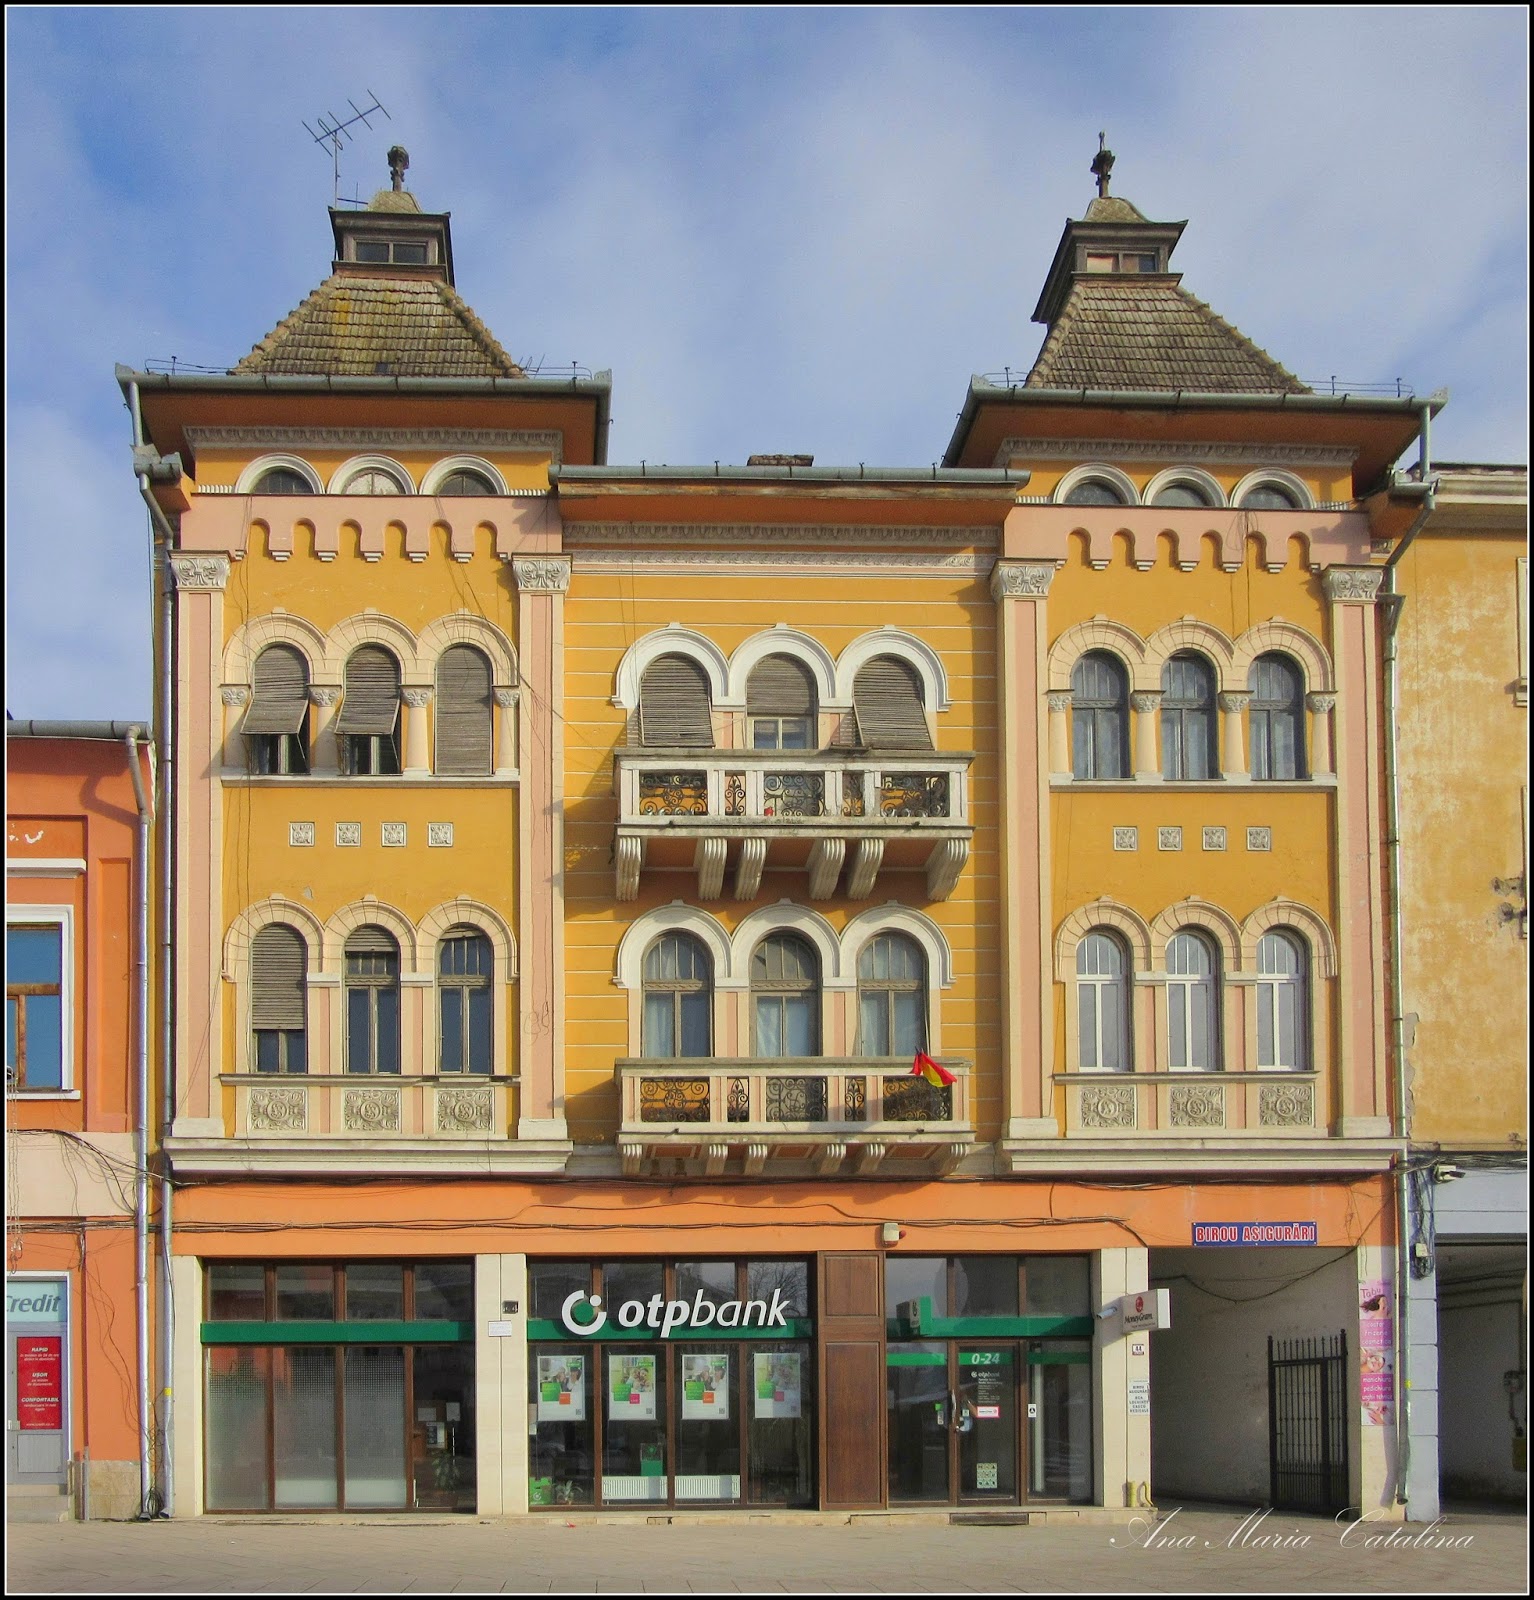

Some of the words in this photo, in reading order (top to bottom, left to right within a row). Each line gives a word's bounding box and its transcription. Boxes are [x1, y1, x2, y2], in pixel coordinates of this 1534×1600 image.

[1196, 1226, 1238, 1242] BIROU
[1242, 1223, 1315, 1242] ASIGURĂRI
[1360, 1288, 1381, 1298] Tabu
[618, 1288, 790, 1338] otpbank
[971, 1353, 1000, 1365] 0-24
